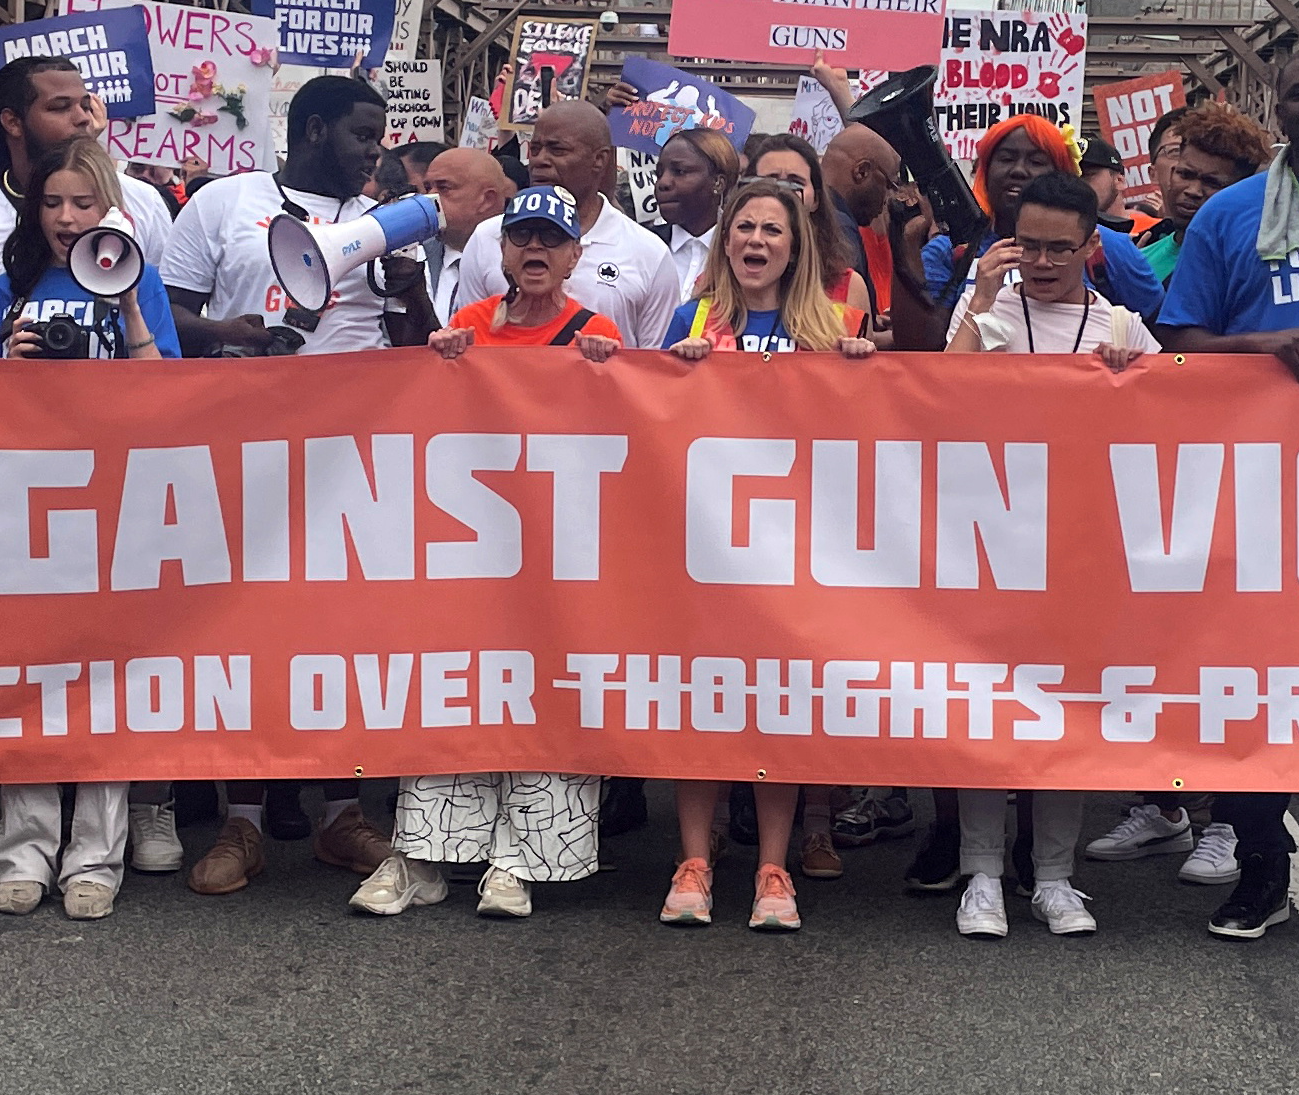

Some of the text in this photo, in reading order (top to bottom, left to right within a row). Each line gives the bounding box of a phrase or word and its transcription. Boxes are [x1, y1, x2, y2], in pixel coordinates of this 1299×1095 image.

[275, 7, 373, 35] FOR OUR
[980, 18, 1051, 52] NRA
[3, 25, 108, 65] MARCH
[278, 32, 339, 55] LIVES
[773, 26, 846, 49] GUNS
[385, 61, 428, 73] SHOULD
[946, 59, 1028, 89] BLOOD
[154, 74, 187, 94] OT
[389, 76, 405, 88] BE
[935, 103, 1001, 131] THEIR
[1106, 84, 1174, 127] NOT
[628, 119, 665, 139] NOT
[1113, 123, 1155, 160] ON
[513, 193, 575, 227] VOTE
[685, 436, 1048, 592] GUN
[289, 649, 536, 731] OVER
[566, 652, 1065, 742] THOUGHTS
[1101, 666, 1163, 745] &
